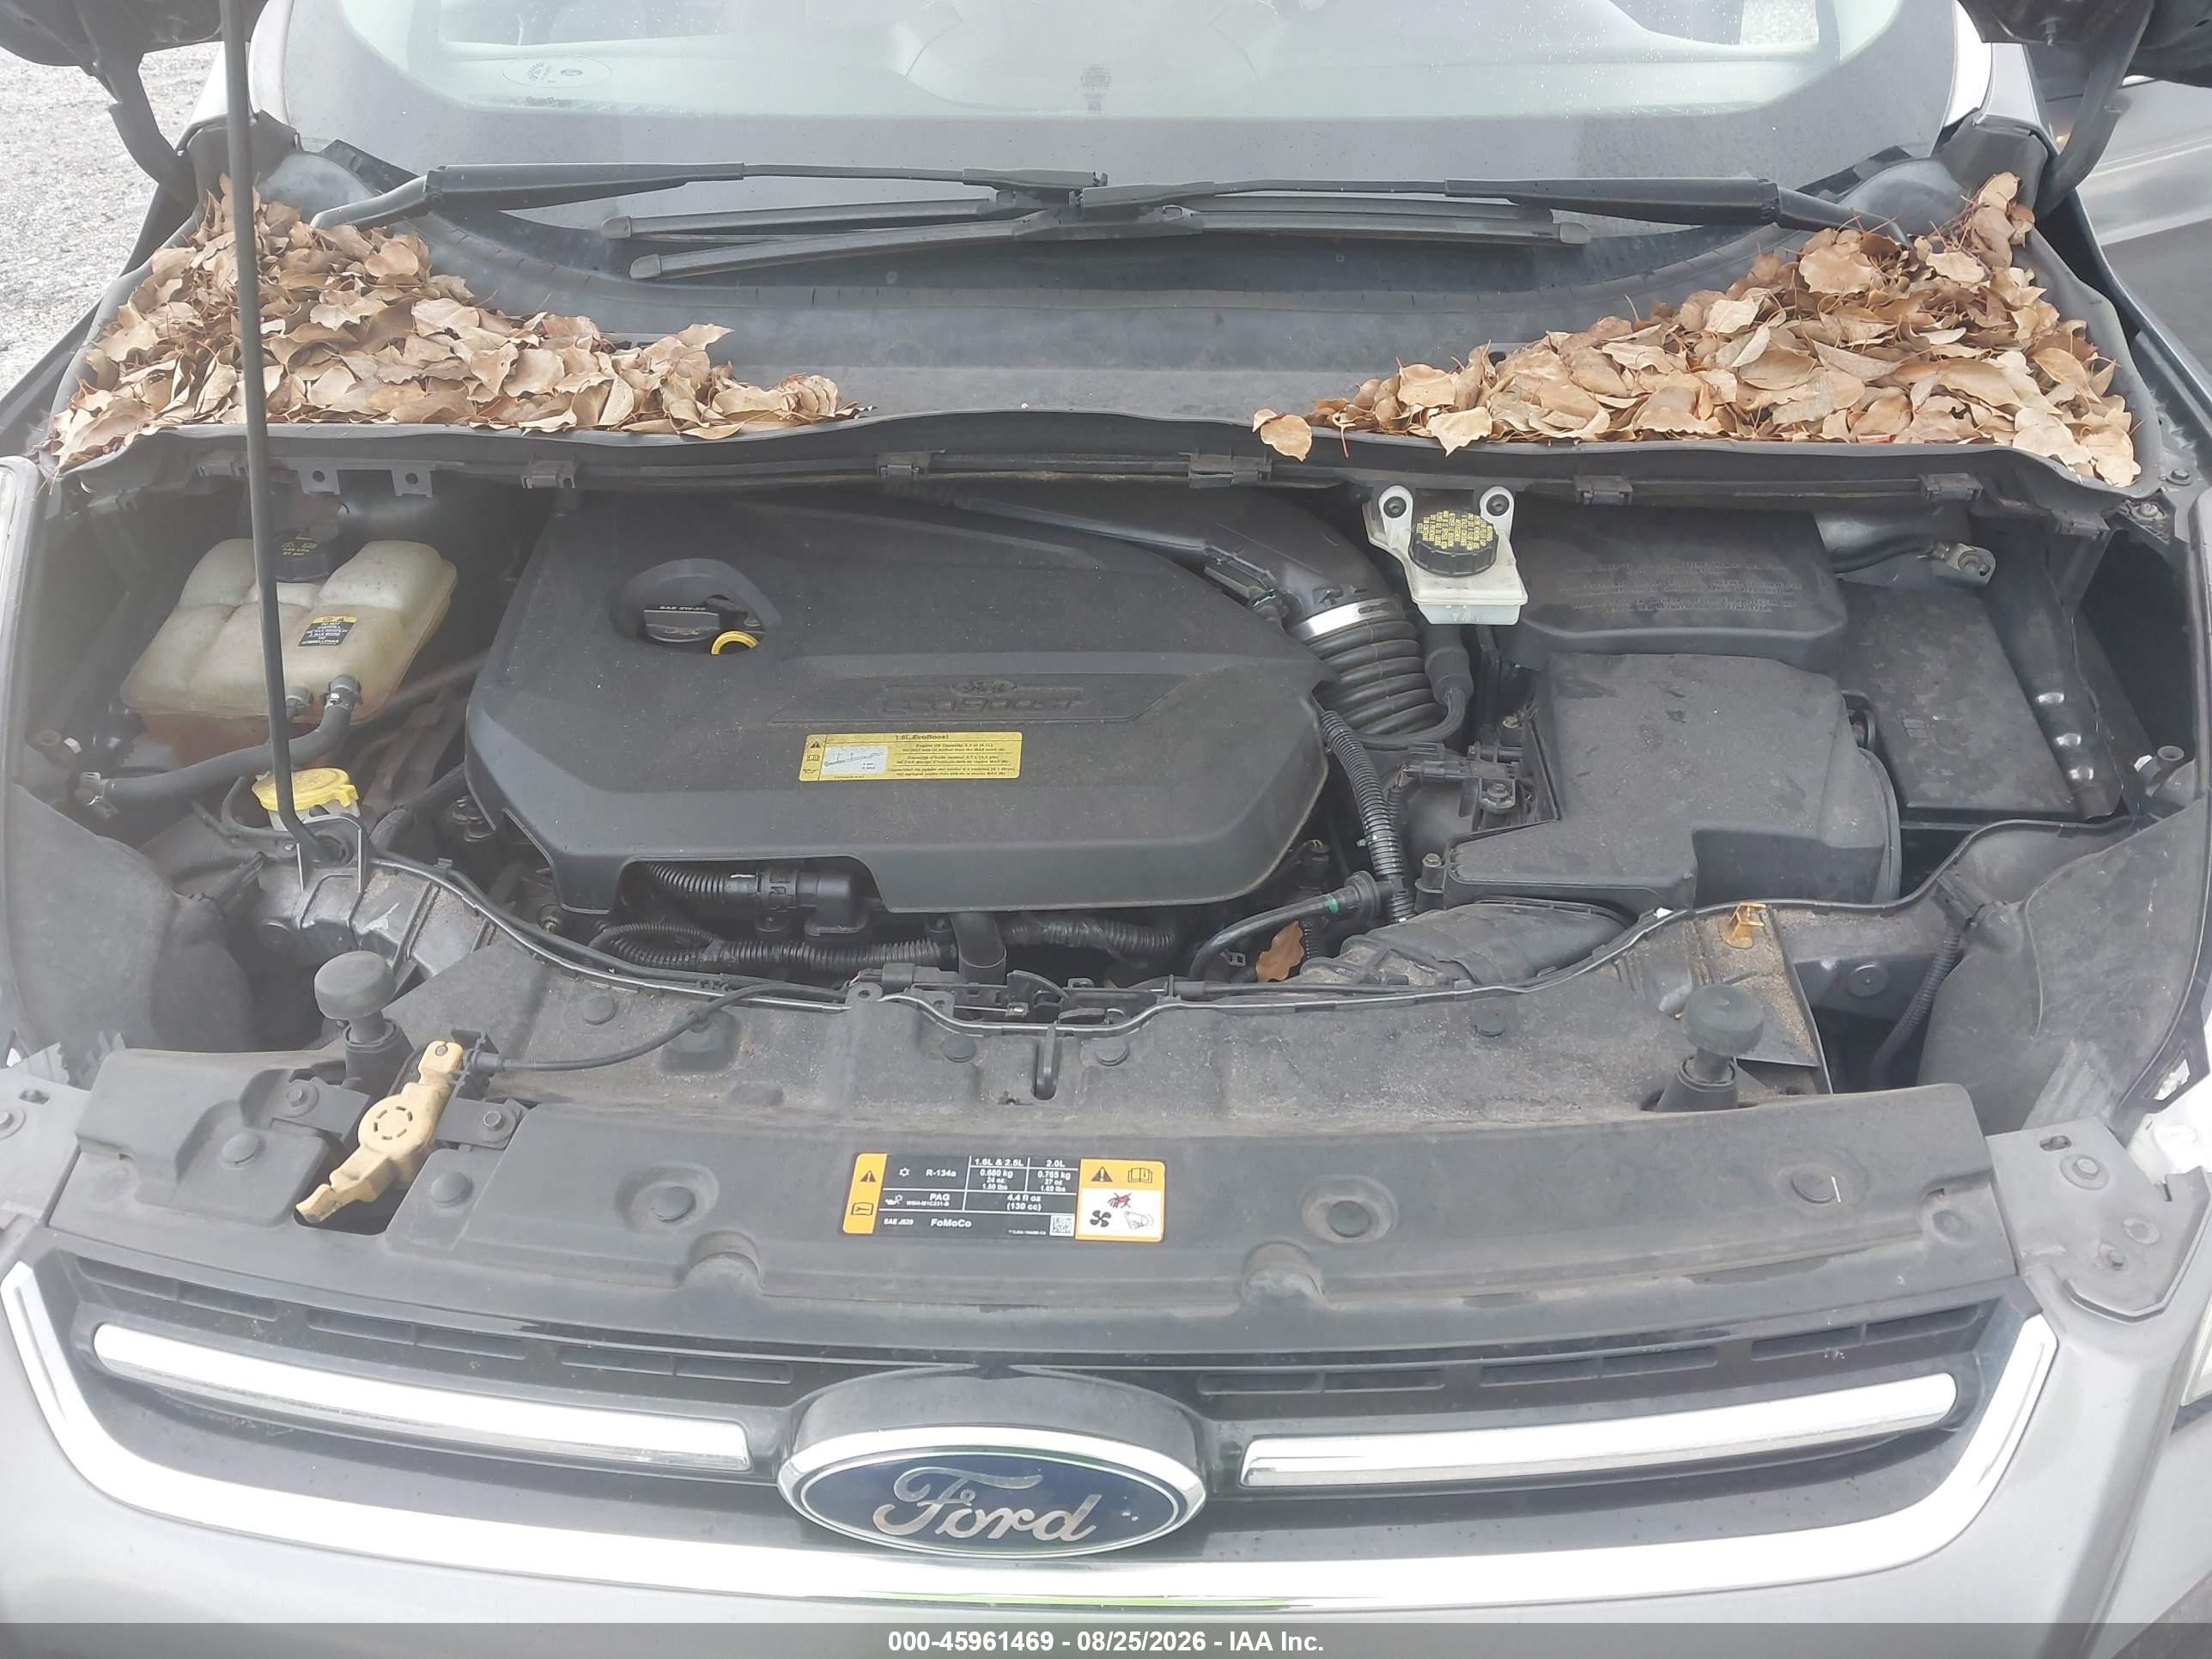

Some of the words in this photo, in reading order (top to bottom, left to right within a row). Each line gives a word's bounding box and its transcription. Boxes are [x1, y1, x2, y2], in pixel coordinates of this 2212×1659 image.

[1046, 1159, 1066, 1168] 2.0L
[926, 1169, 957, 1177] R-134a
[980, 1169, 1001, 1177] 0.680
[1002, 1170, 1013, 1179] kg
[1037, 1170, 1060, 1179] 0.765
[1060, 1171, 1071, 1181] kg
[929, 1193, 951, 1201] PAG
[1006, 1202, 1026, 1211] (130
[1027, 1203, 1042, 1212] cc)
[930, 1218, 972, 1228] FoMoCo
[873, 1467, 1102, 1542] Ford
